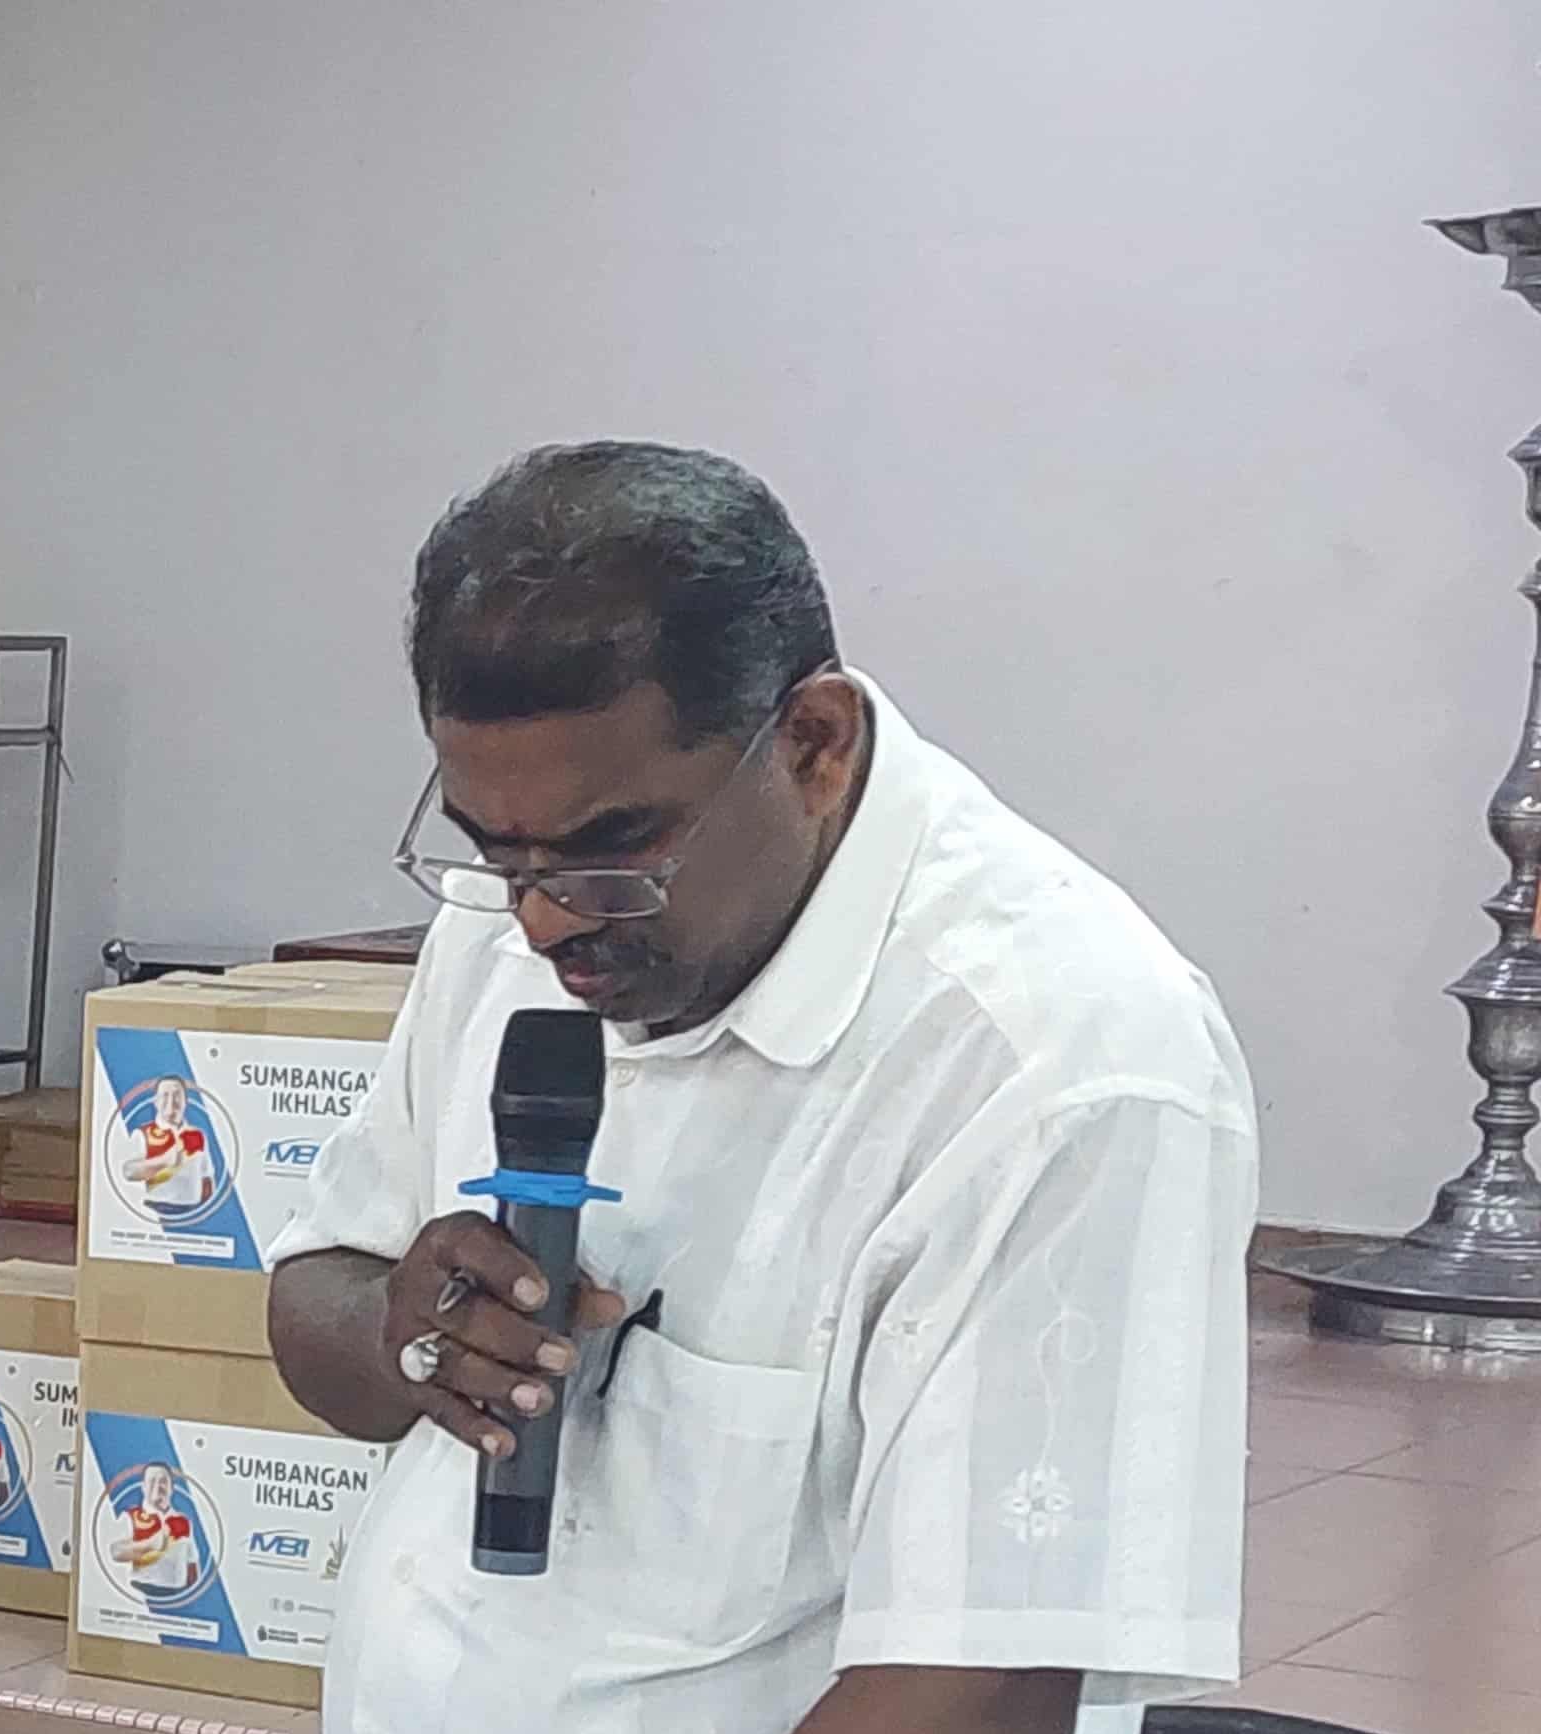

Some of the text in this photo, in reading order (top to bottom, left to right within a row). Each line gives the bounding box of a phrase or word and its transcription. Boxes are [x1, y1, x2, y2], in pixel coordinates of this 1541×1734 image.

[239, 1064, 376, 1093] SUMBANGA
[271, 1091, 351, 1118] IKHLAS
[224, 1455, 368, 1492] SUMBANGAN
[255, 1483, 334, 1512] IKHLAS
